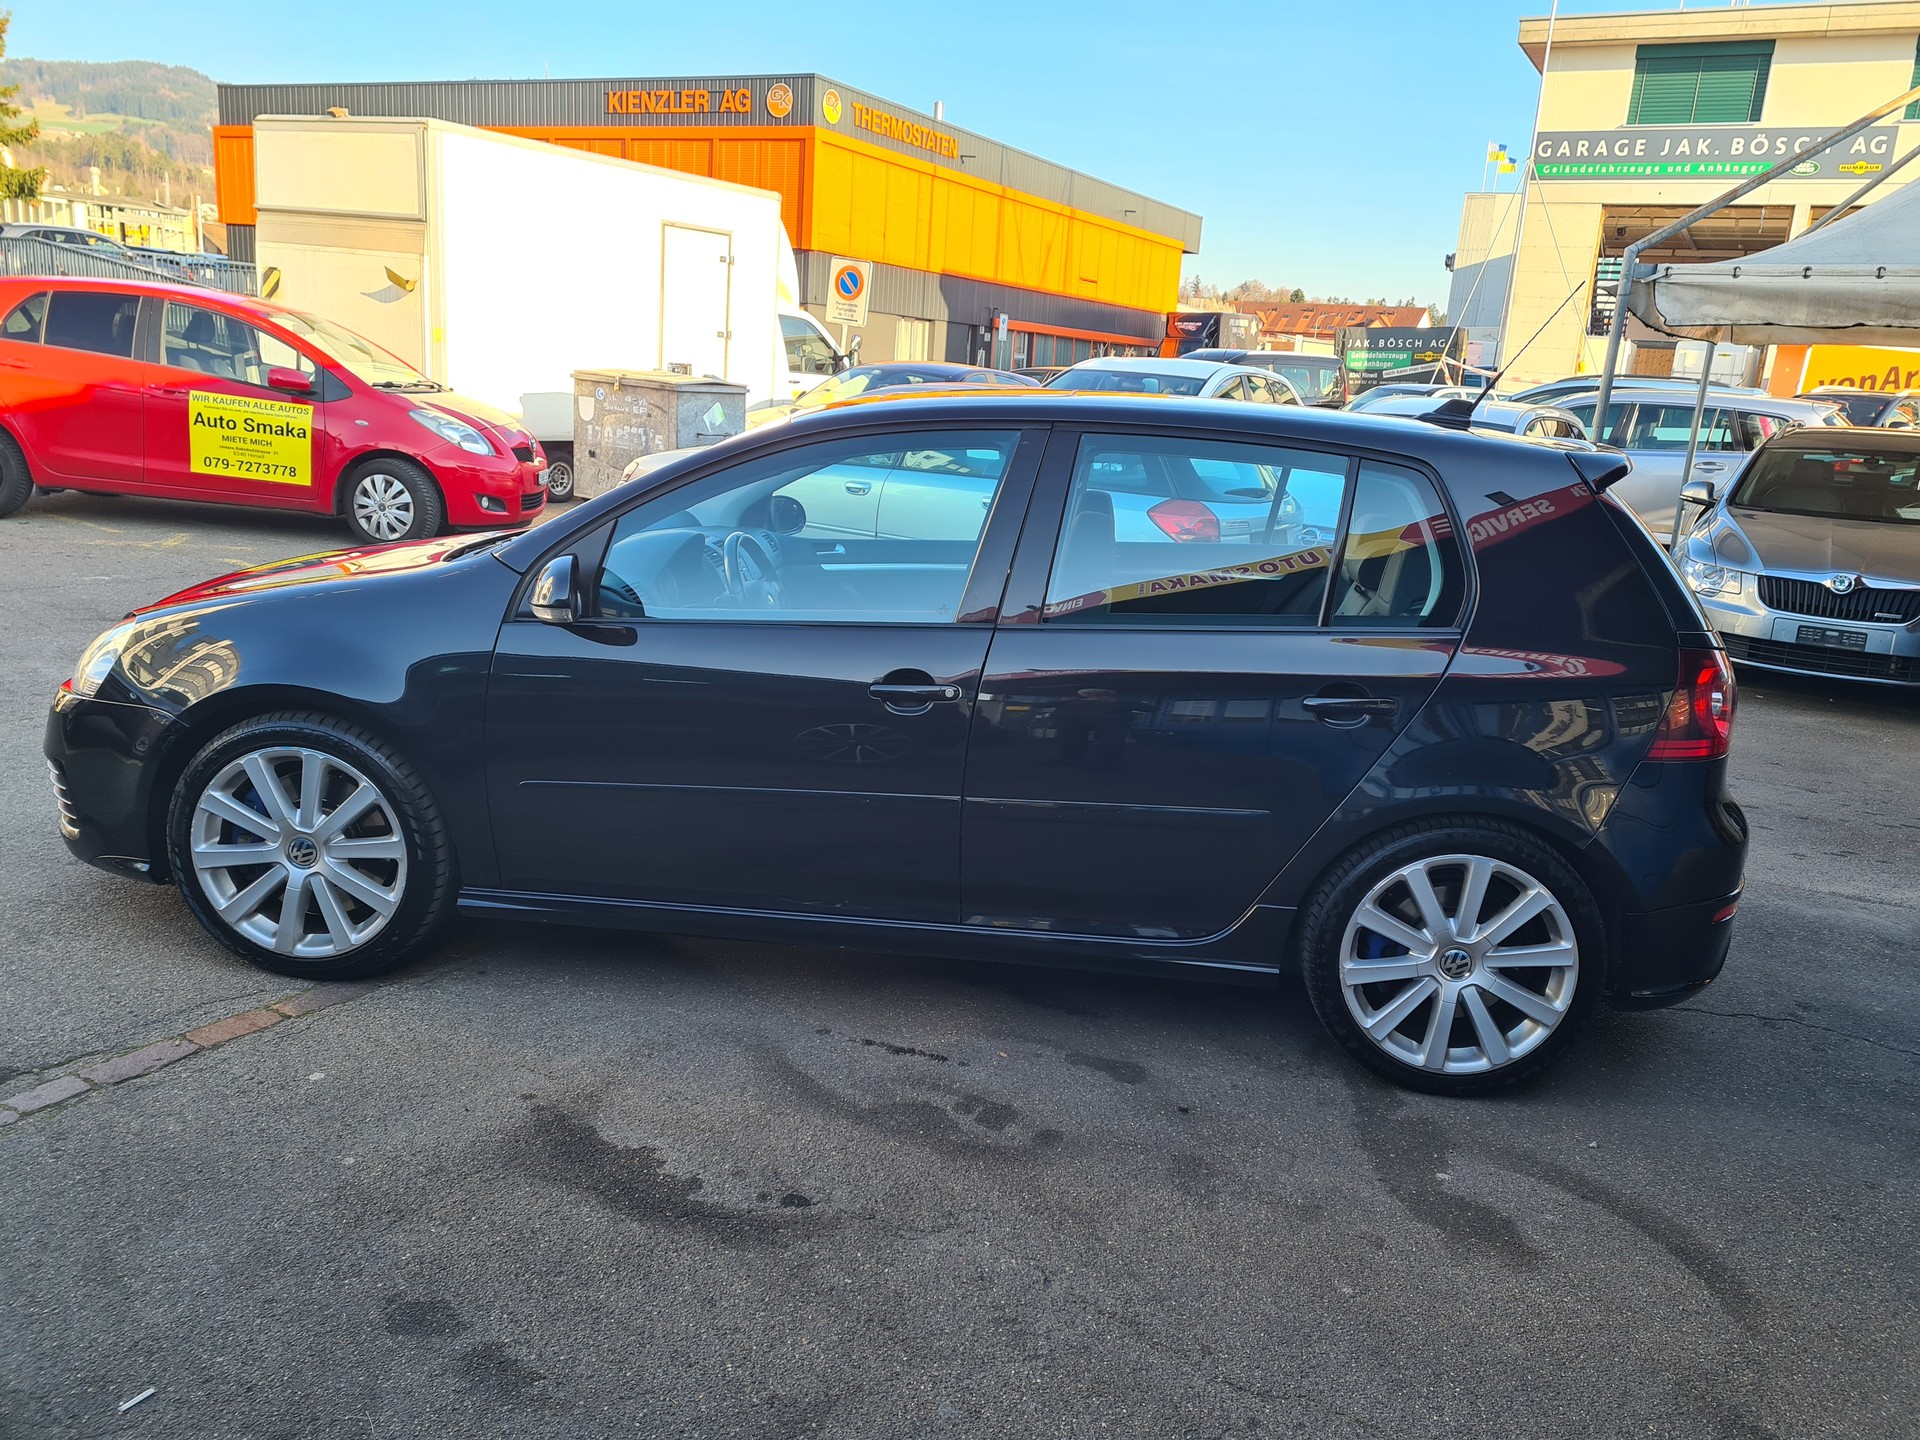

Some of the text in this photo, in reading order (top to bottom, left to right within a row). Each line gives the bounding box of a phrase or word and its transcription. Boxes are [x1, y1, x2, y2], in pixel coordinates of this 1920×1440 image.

[608, 88, 751, 114] KIENZLER AG
[851, 101, 959, 160] THERMOSTATEN
[1537, 133, 1889, 158] GARAGE JAK. BÖSC AG
[1543, 162, 1764, 175] Geländefahrzeuge und Anhänger
[1347, 337, 1446, 348] JAK. BÖSCH AG
[191, 393, 310, 415] WIR KAUFEN ALLE AUTOS
[193, 411, 307, 439] Auto Smaka
[221, 434, 272, 447] MIETE MICH
[203, 456, 297, 478] 079-7273778
